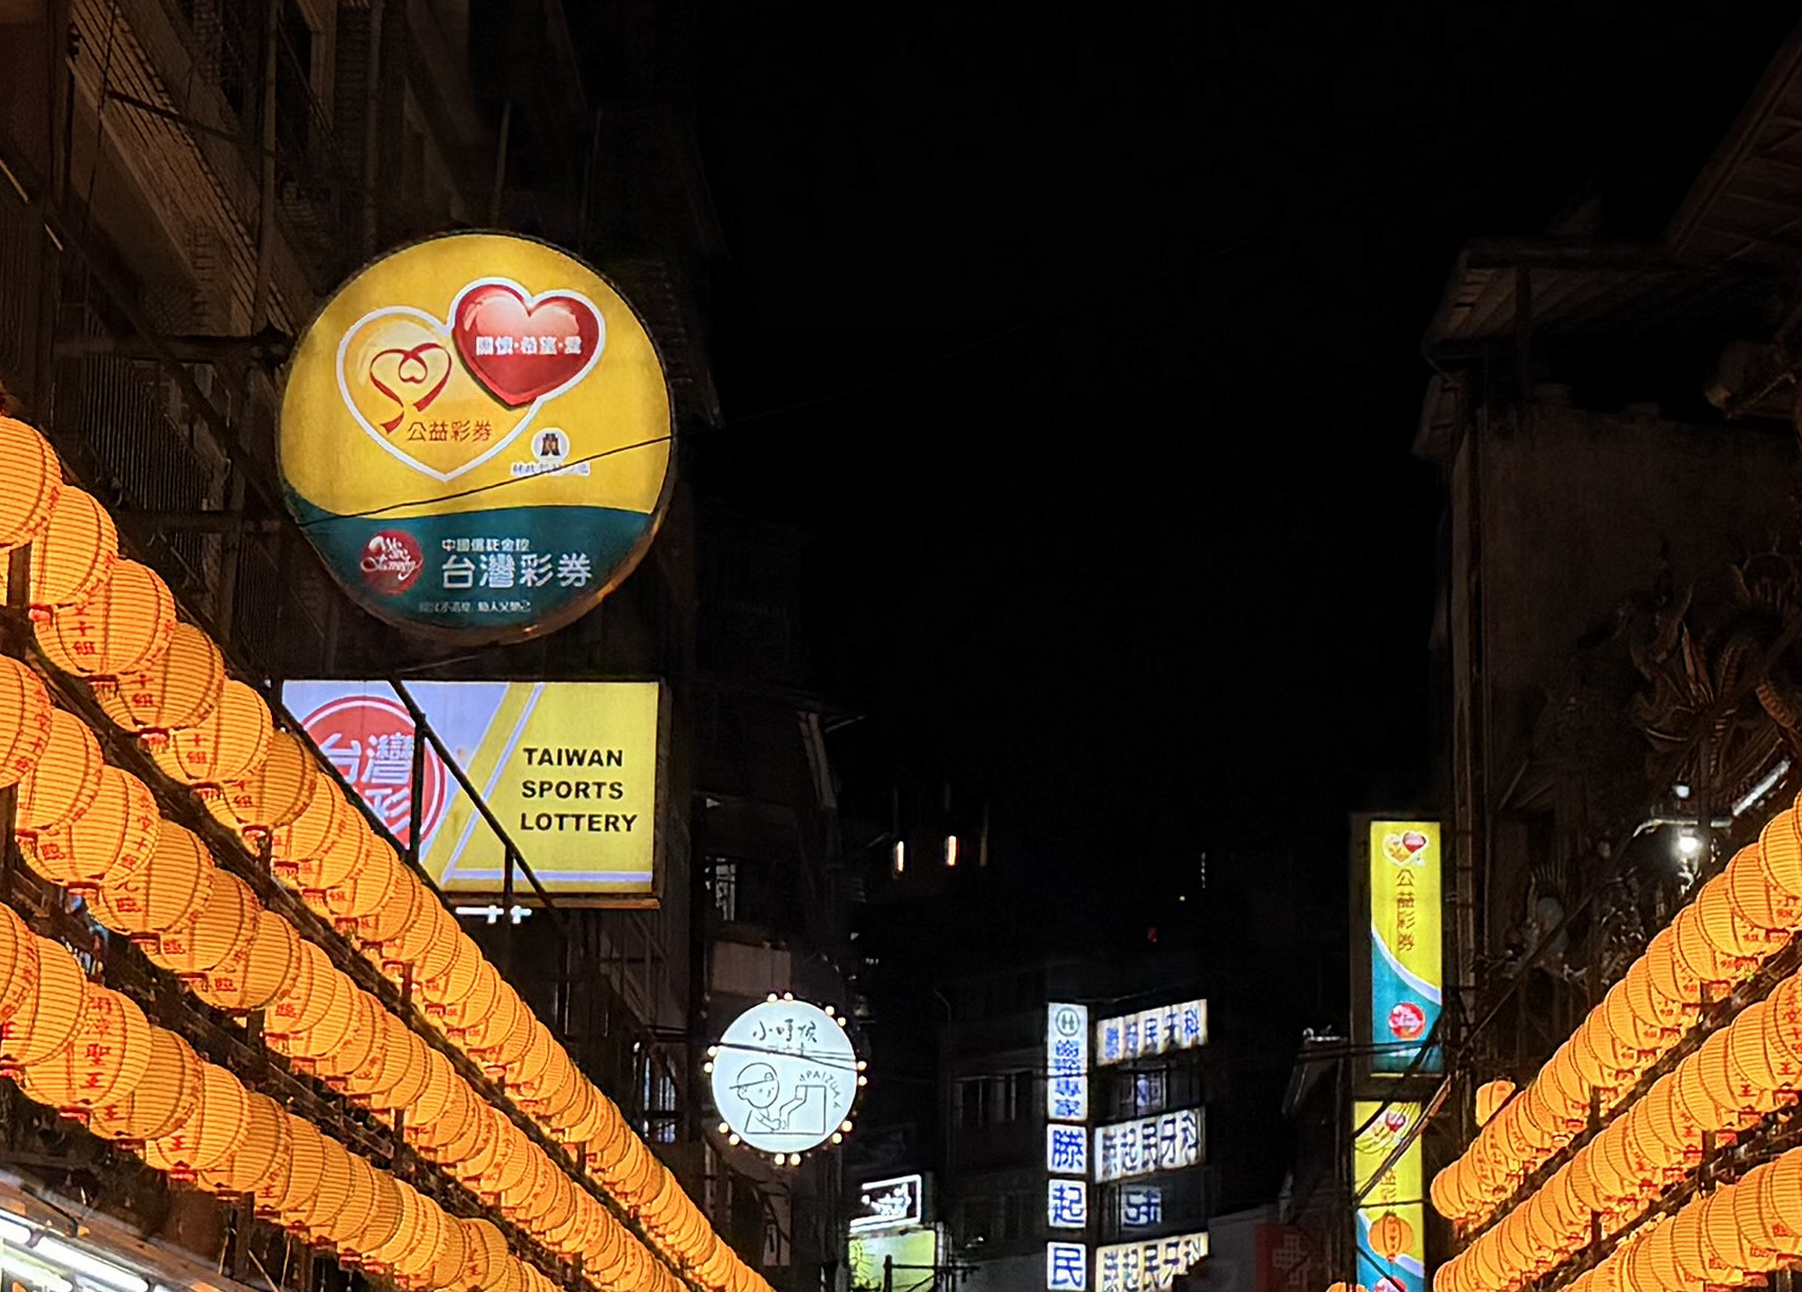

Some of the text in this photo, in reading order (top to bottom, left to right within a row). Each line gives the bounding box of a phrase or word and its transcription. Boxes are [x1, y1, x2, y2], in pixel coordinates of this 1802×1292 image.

[406, 419, 493, 444] 公益彩券
[441, 552, 594, 589] 台灣彩券
[320, 731, 415, 785] 台灣
[521, 745, 625, 769] TAIWAN
[520, 778, 625, 801] SPORTS
[519, 811, 639, 834] LOTTERY
[1395, 868, 1417, 952] 公益彩券
